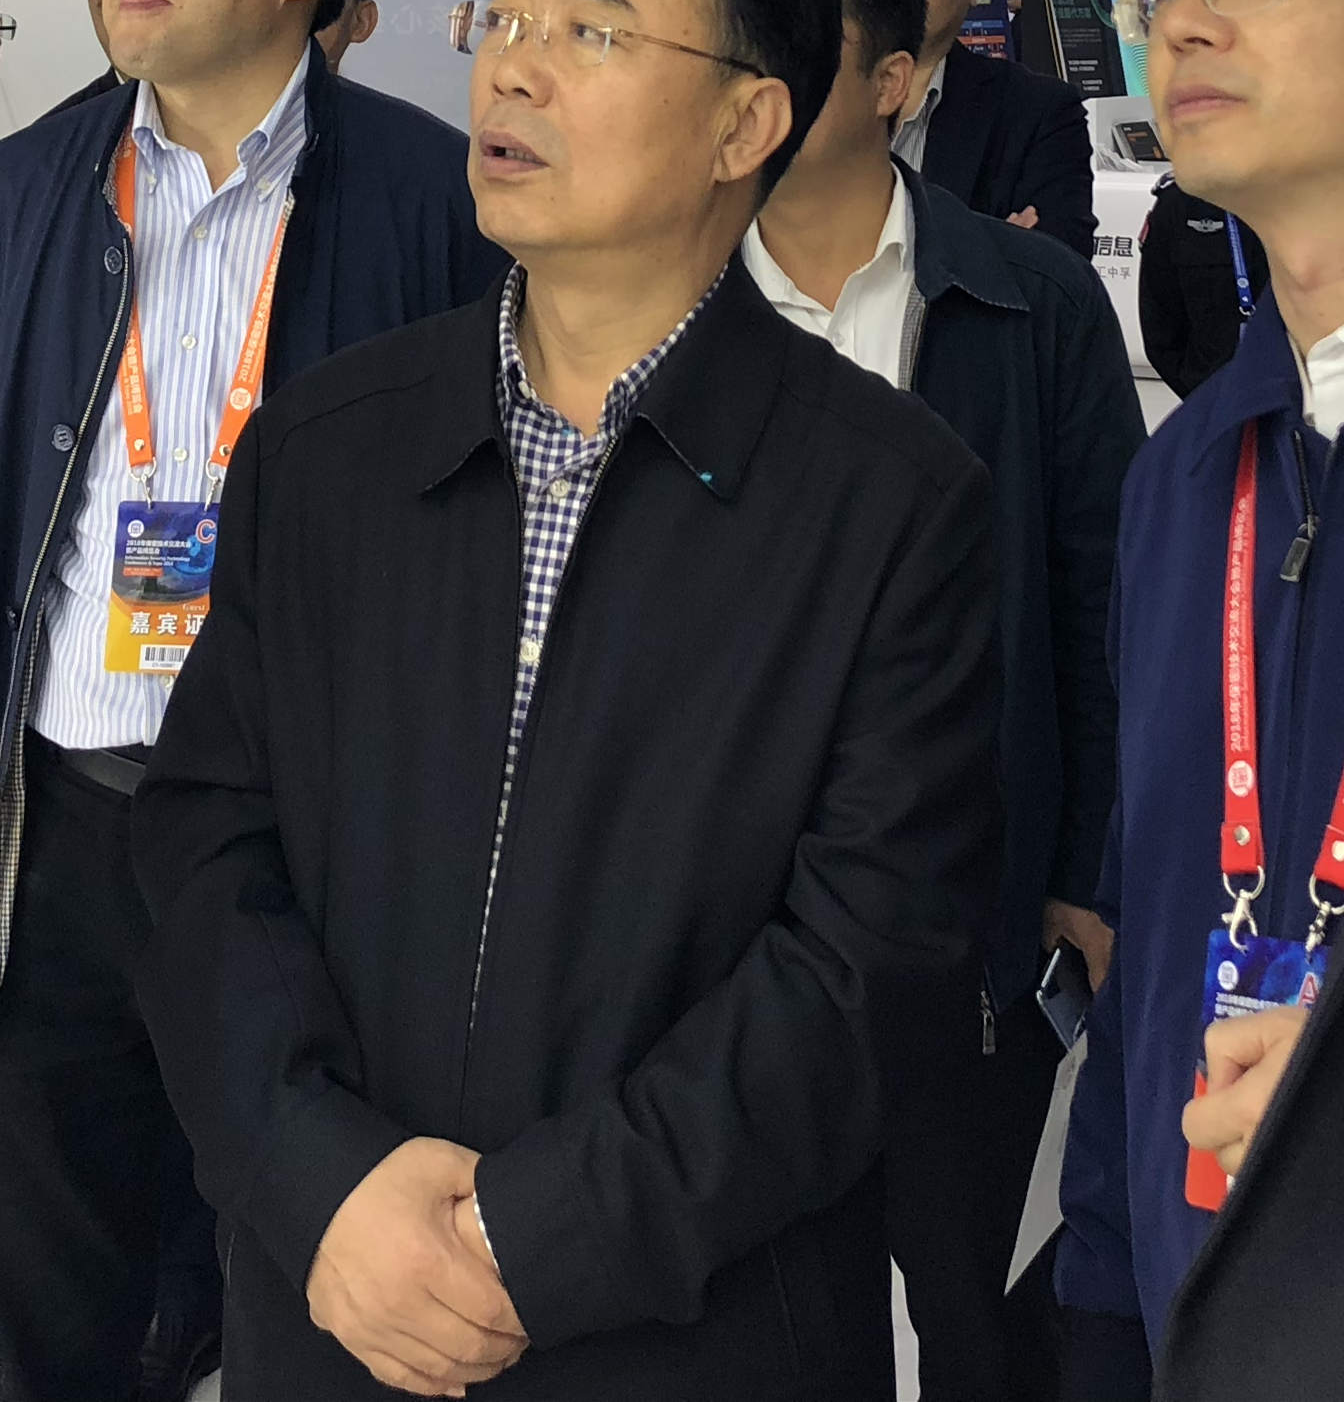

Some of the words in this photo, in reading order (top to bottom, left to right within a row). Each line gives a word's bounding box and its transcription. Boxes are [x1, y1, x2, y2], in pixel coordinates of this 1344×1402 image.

[1093, 235, 1134, 258] 信息
[196, 518, 217, 544] C
[130, 611, 206, 635] 嘉宾证
